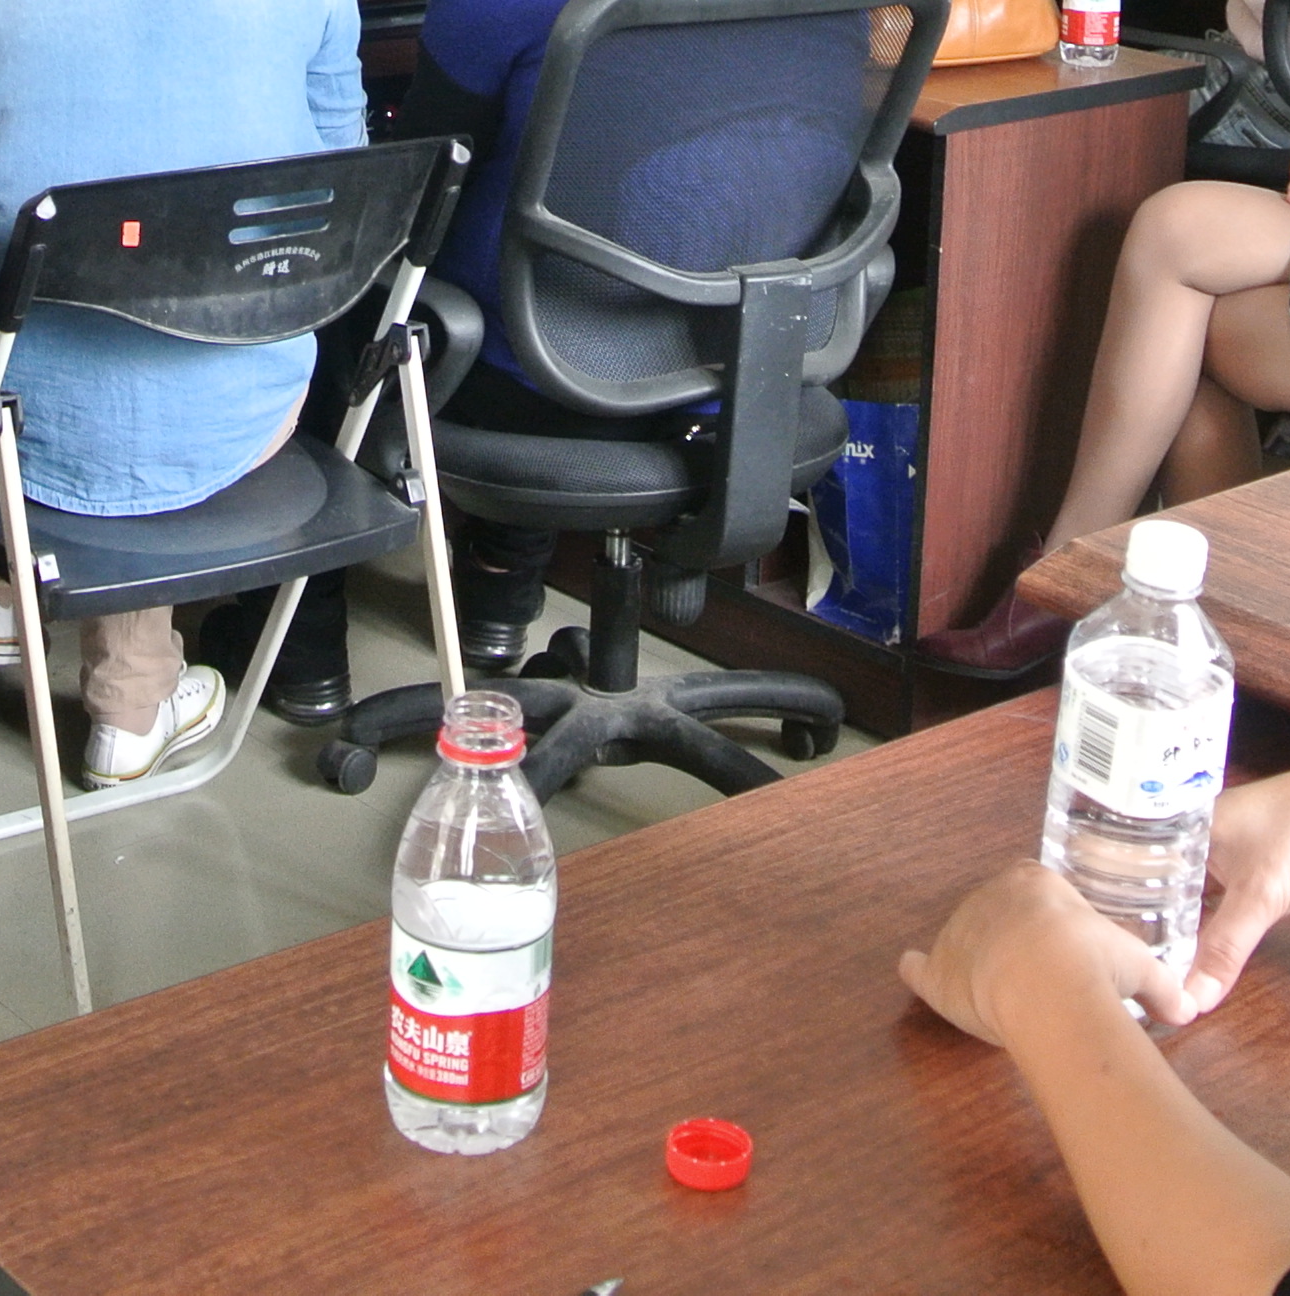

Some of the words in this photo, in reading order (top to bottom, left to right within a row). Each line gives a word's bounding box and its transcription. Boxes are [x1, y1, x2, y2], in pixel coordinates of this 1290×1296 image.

[390, 1004, 470, 1057] 农夫山泉
[422, 1051, 469, 1073] SPRING
